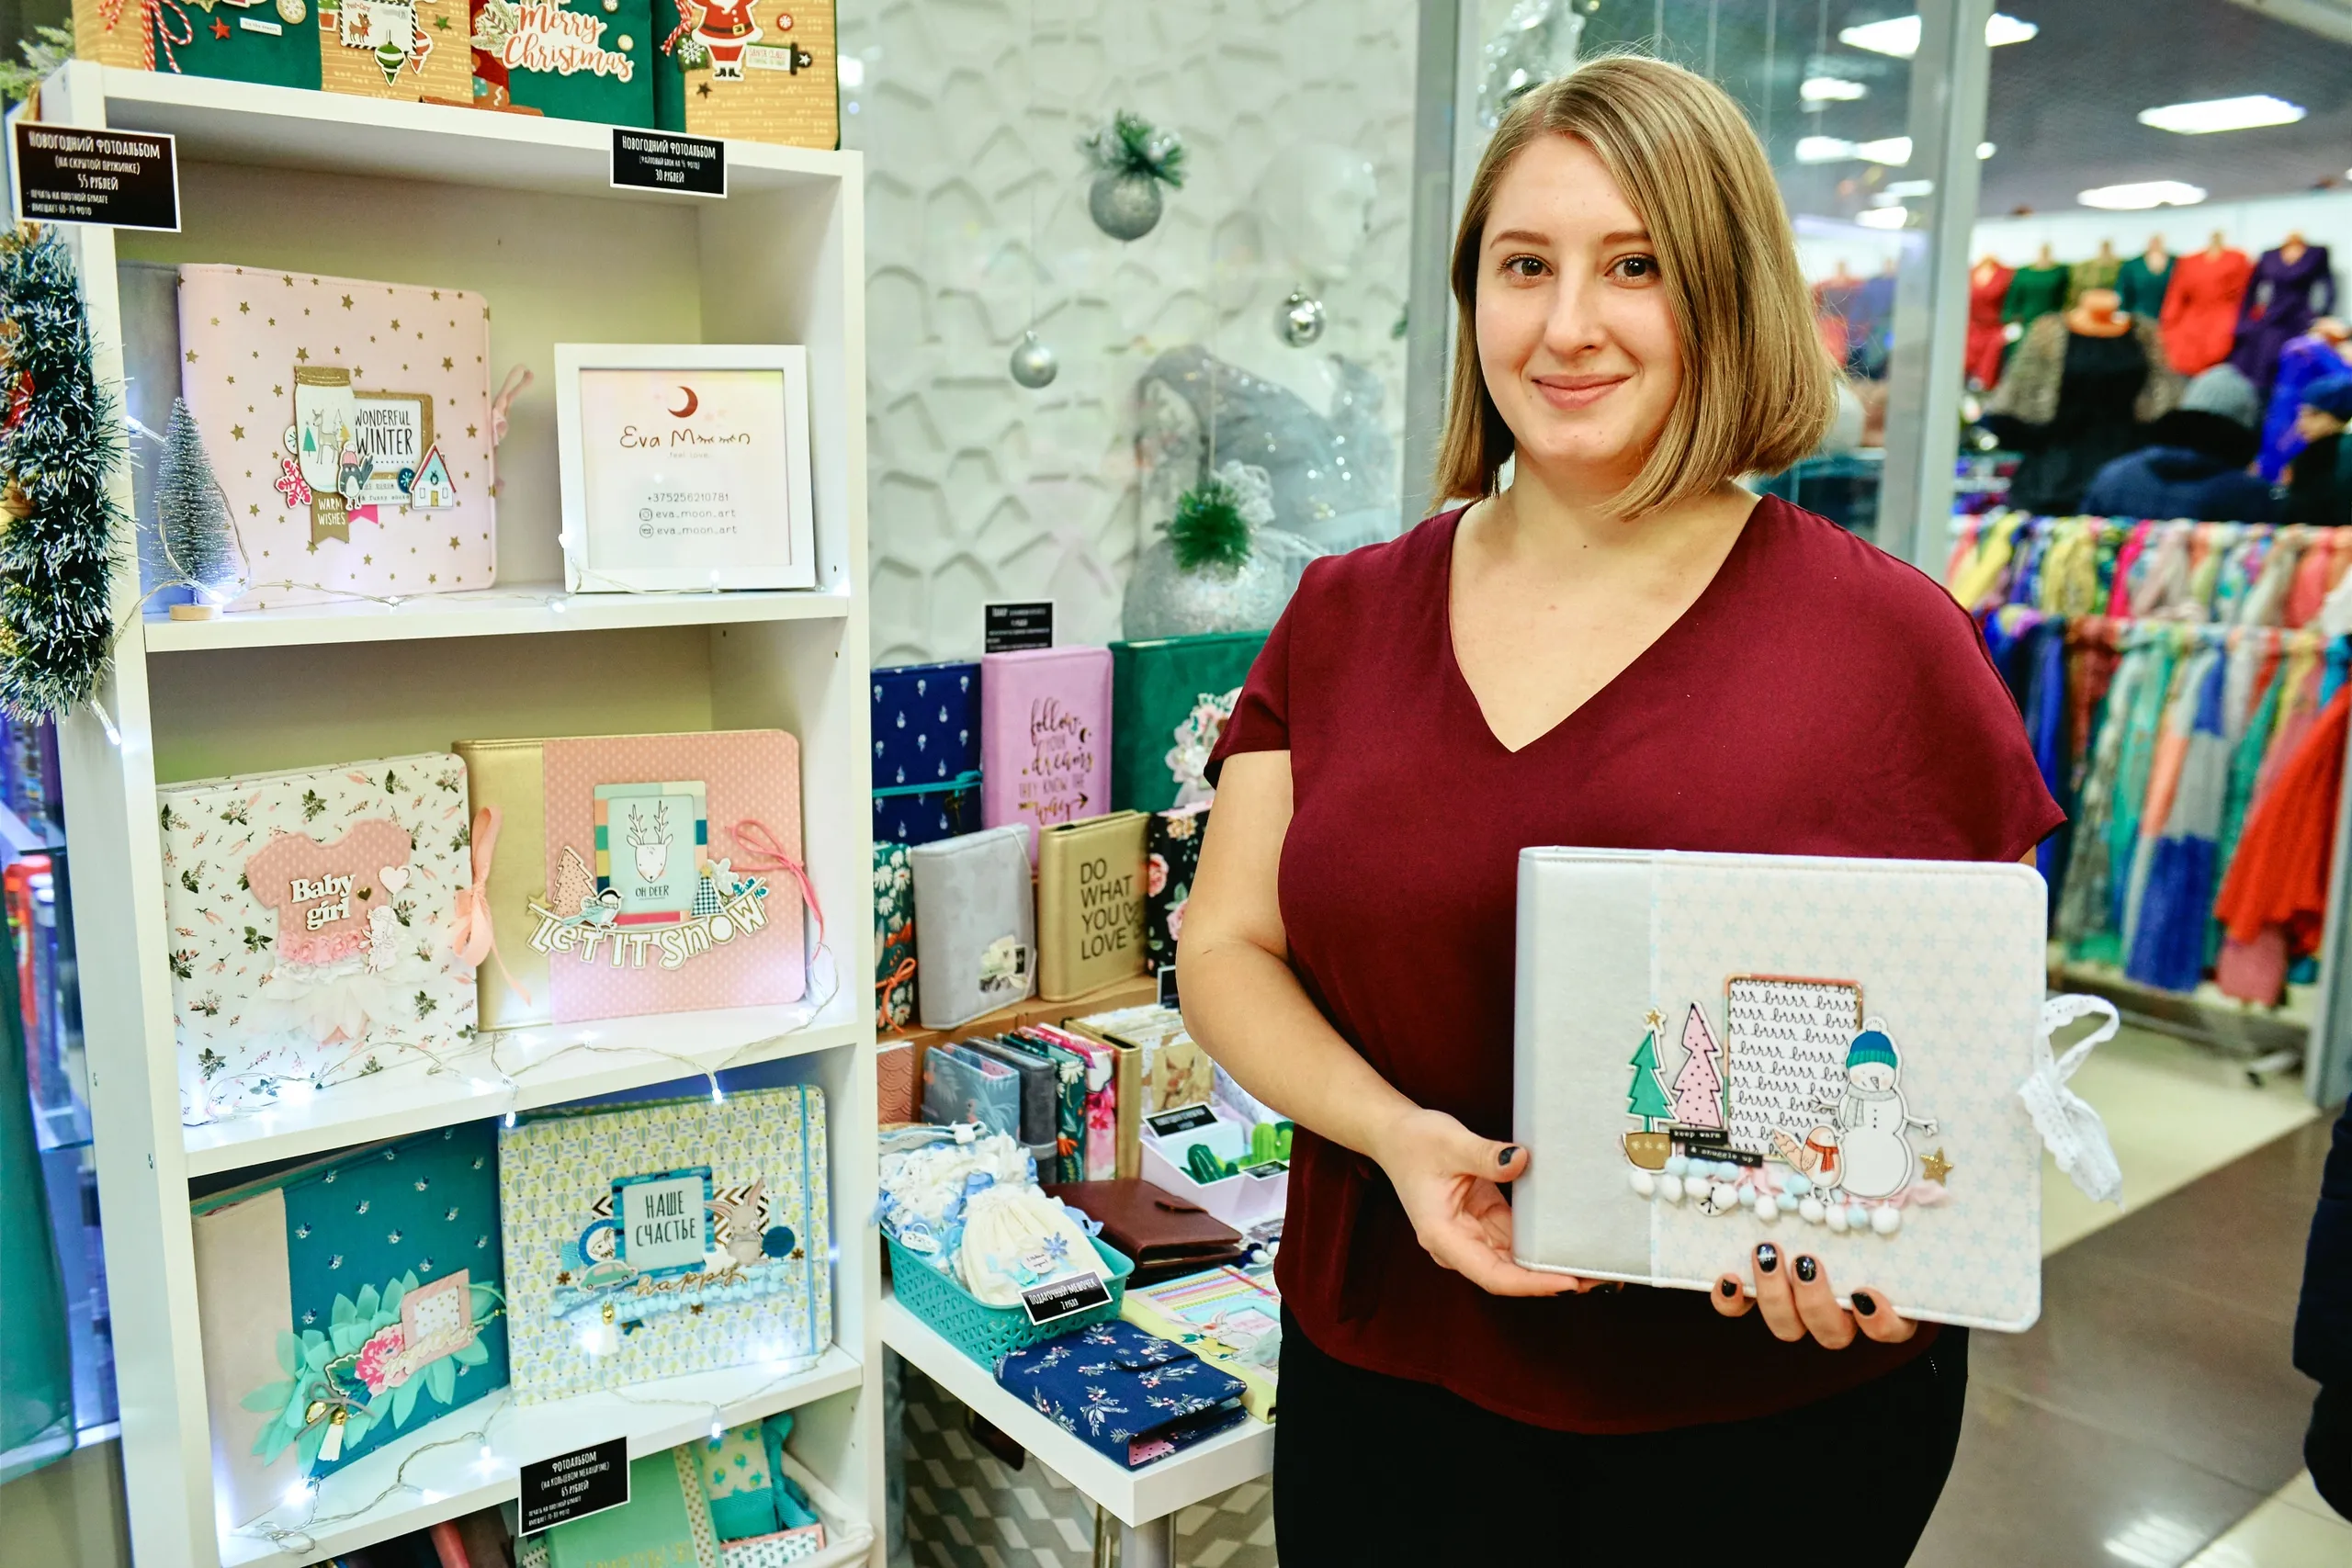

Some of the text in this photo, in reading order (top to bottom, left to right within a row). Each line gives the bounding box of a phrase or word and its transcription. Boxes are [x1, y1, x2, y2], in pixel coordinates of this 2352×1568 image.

[514, 3, 604, 44] Merry
[504, 33, 630, 78] Christmas
[28, 130, 161, 160] НОВОГОДНИЙ ФОТОАЛЬБОМ
[622, 135, 717, 161] НОВОГОДНИЙ ФОТОАЛЬБОМ
[55, 154, 141, 175] (НА СКРЫТОЙ ПРУЖИНКЕ)
[655, 168, 685, 184] 30 РУБЛЕЙ
[77, 173, 119, 191] 55 РУБЛЕЙ
[355, 408, 411, 427] WONDERFUL
[355, 426, 413, 456] WINTER
[619, 425, 661, 449] Eva
[318, 497, 344, 511] WARM
[317, 512, 346, 525] WISHES
[1080, 857, 1108, 886] DO
[288, 873, 356, 904] Baby
[635, 885, 670, 897] OH DEER
[1080, 874, 1134, 909] WHAT
[306, 896, 351, 931] girl
[1080, 903, 1120, 935] YOU
[609, 932, 653, 968] IT
[1080, 925, 1127, 962] LOVE
[1674, 1131, 1695, 1139] keep
[1701, 1148, 1738, 1160] snuggle
[1742, 1155, 1754, 1164] up
[645, 1190, 685, 1220] НАШЕ
[635, 1217, 696, 1247] СЧАСТЬЕ
[635, 1267, 749, 1297] happy
[1028, 1277, 1098, 1305] ПОДАРОЧНЫЙ МЕШОЧЕК
[551, 1450, 597, 1473] ФОТОАЛЬБОМ
[569, 1479, 590, 1495] РУБЛЕЙ
